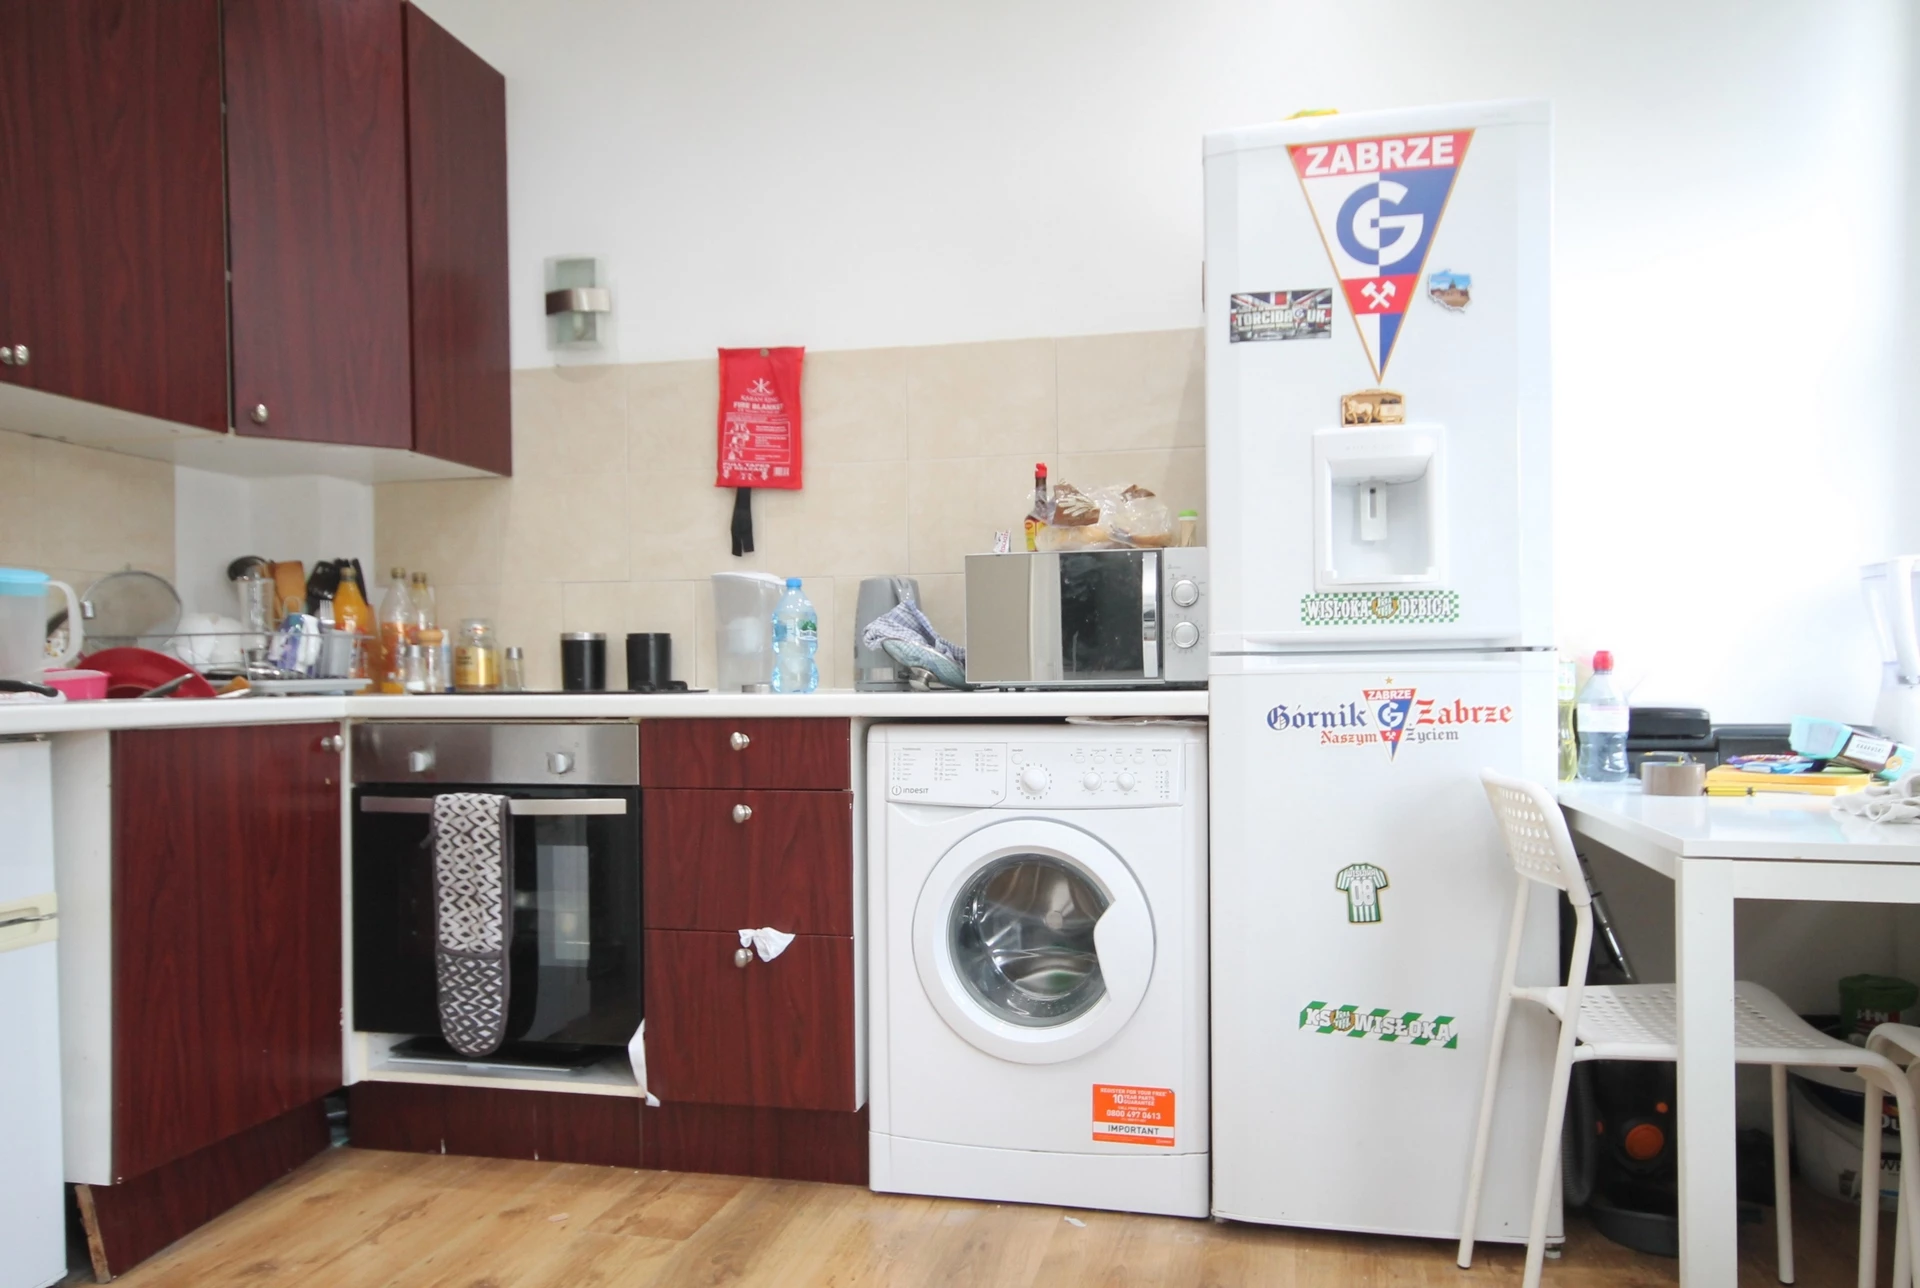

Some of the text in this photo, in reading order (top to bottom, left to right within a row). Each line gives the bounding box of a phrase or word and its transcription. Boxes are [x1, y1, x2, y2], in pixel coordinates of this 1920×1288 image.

[1305, 135, 1454, 176] ZABRZE
[1236, 308, 1326, 326] TORCIDA UK
[733, 401, 750, 409] FIRE
[1367, 689, 1413, 701] ZABRZE
[1267, 698, 1513, 731] Górnik Zabrze
[1320, 723, 1459, 746] Naszym Życiem
[1351, 879, 1375, 906] 08
[1305, 1007, 1451, 1042] KS WISŁOKA
[1100, 1087, 1125, 1095] REGISTER
[1113, 1094, 1124, 1104] 10
[1106, 1109, 1125, 1117] 0800
[1126, 1111, 1140, 1119] 497
[1142, 1112, 1161, 1120] 0613
[1108, 1124, 1160, 1135] IMPORTANT
